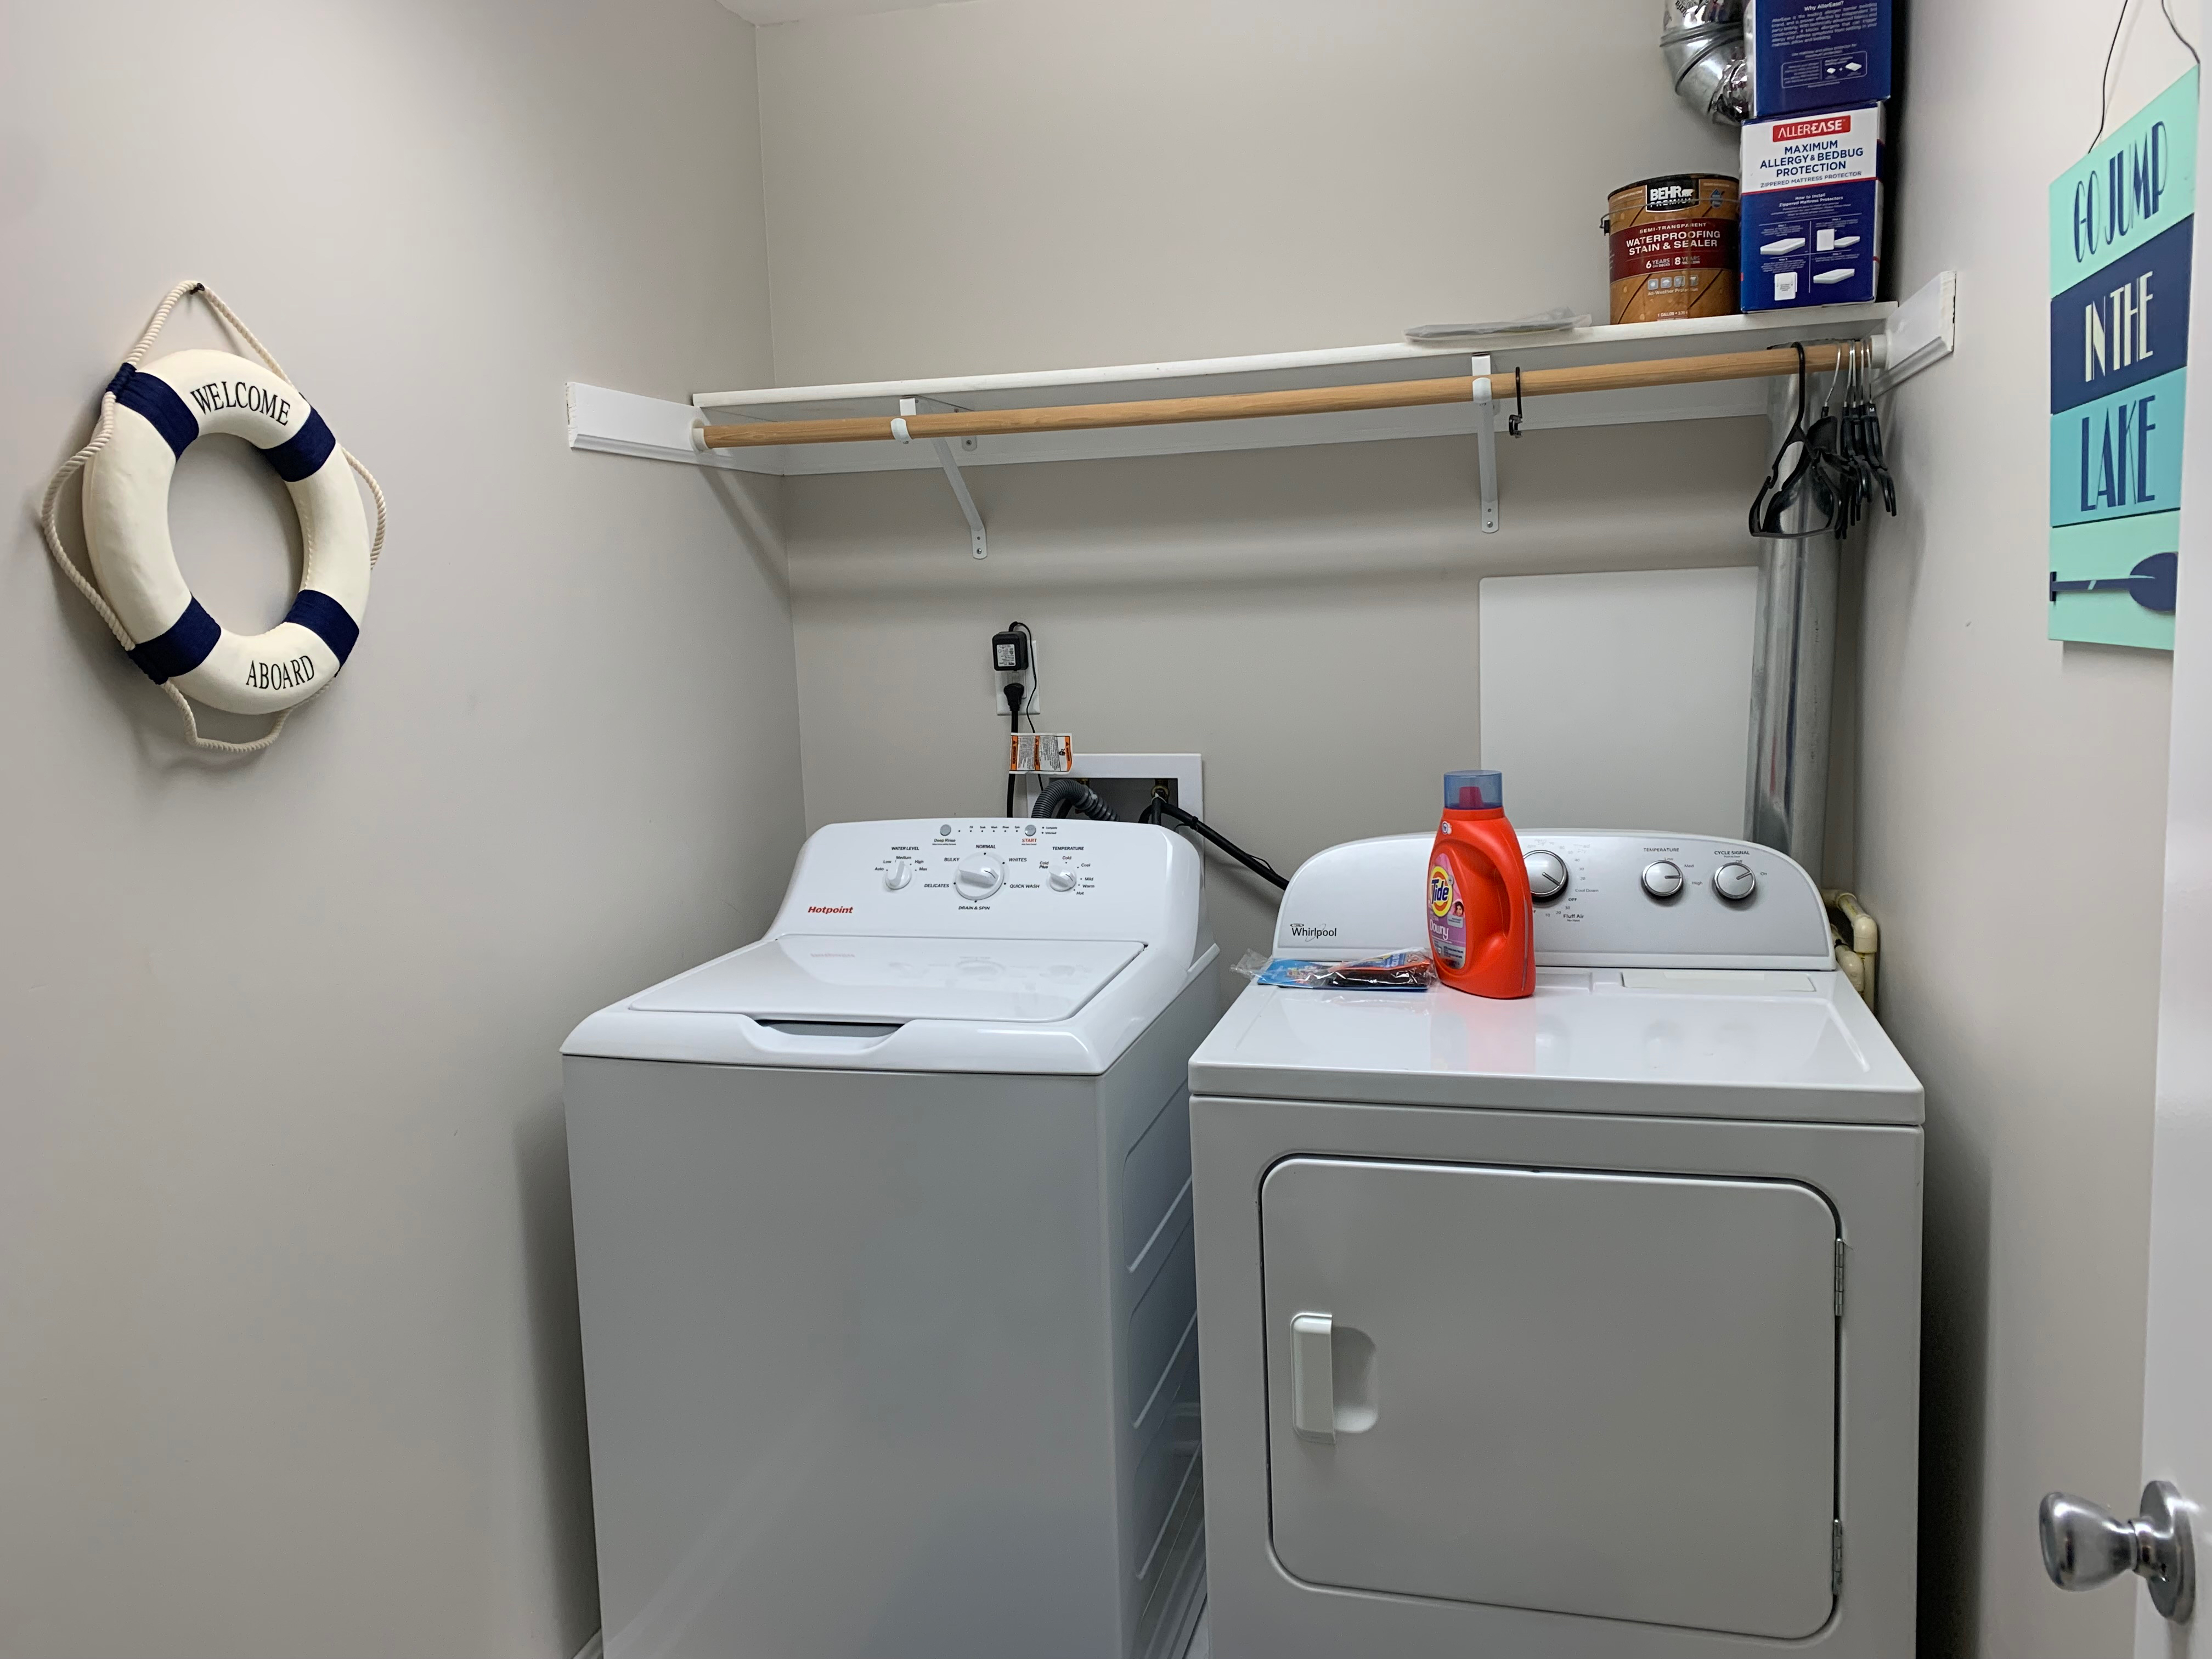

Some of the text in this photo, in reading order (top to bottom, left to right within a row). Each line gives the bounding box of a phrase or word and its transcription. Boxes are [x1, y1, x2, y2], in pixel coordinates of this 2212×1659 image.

[1778, 119, 1842, 138] ALLEREASE
[1785, 140, 1838, 155] MAXIMUM
[1760, 154, 1809, 169] ALLERGY
[1818, 148, 1864, 161] BEDBUG
[1776, 161, 1846, 177] PROTECTION
[1791, 176, 1823, 184] MATTRESS
[1824, 171, 1862, 180] PROTECTOR
[1650, 185, 1681, 201] BEHR
[2074, 121, 2168, 263] GO JUMP
[1639, 222, 1707, 234] SEMI-TRANSPARENT
[1626, 230, 1721, 247] WATERPROOFING
[1629, 244, 1660, 256] STAIN
[1674, 239, 1718, 249] SEALER
[1646, 261, 1652, 269] 6
[1674, 257, 1681, 265] 8
[2086, 271, 2153, 382] IN THE
[190, 381, 290, 426] WELCOME
[2081, 395, 2155, 512] LAKE
[246, 655, 314, 691] ABOARD
[1431, 878, 1449, 904] Tide
[808, 906, 853, 915] Hotpoint
[1291, 928, 1336, 939] Whirlpool
[1430, 919, 1449, 940] Downy
